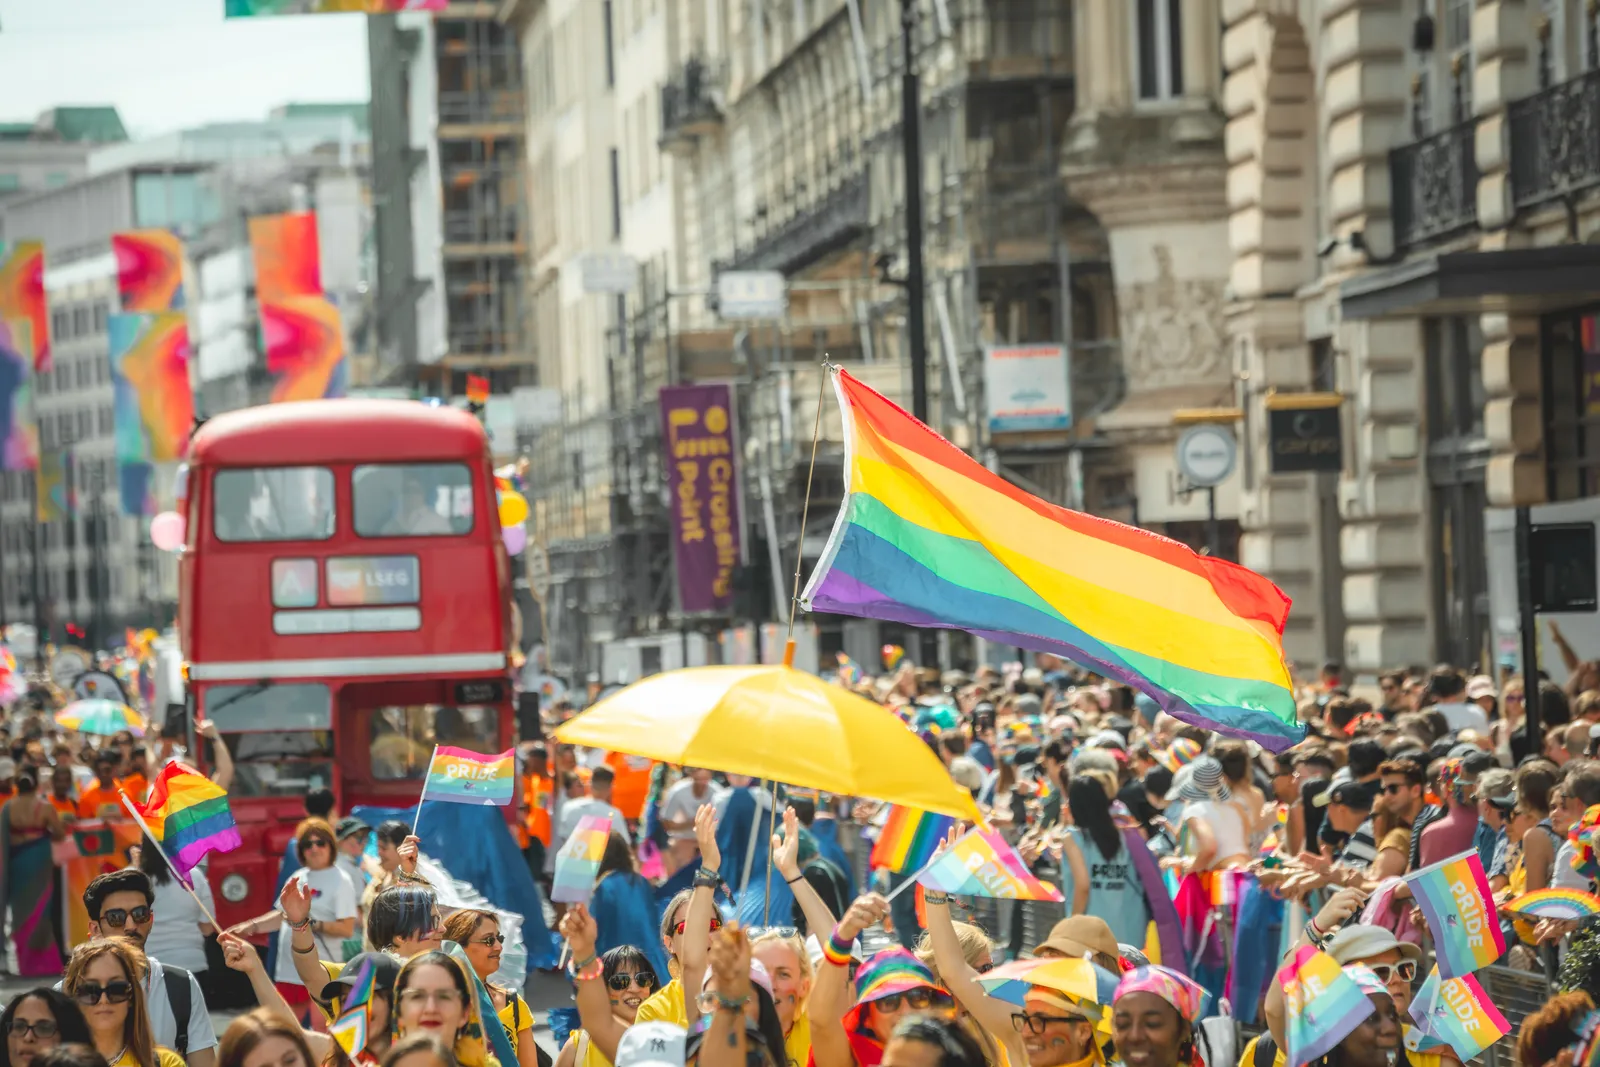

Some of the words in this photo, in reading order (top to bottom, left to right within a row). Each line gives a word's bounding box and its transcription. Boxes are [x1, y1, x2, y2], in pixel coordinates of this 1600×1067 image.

[677, 460, 706, 544] Point
[365, 569, 410, 587] LSEG
[446, 763, 499, 782] PRIDE
[965, 851, 1018, 899] PRID
[1449, 881, 1483, 948] PRIDE
